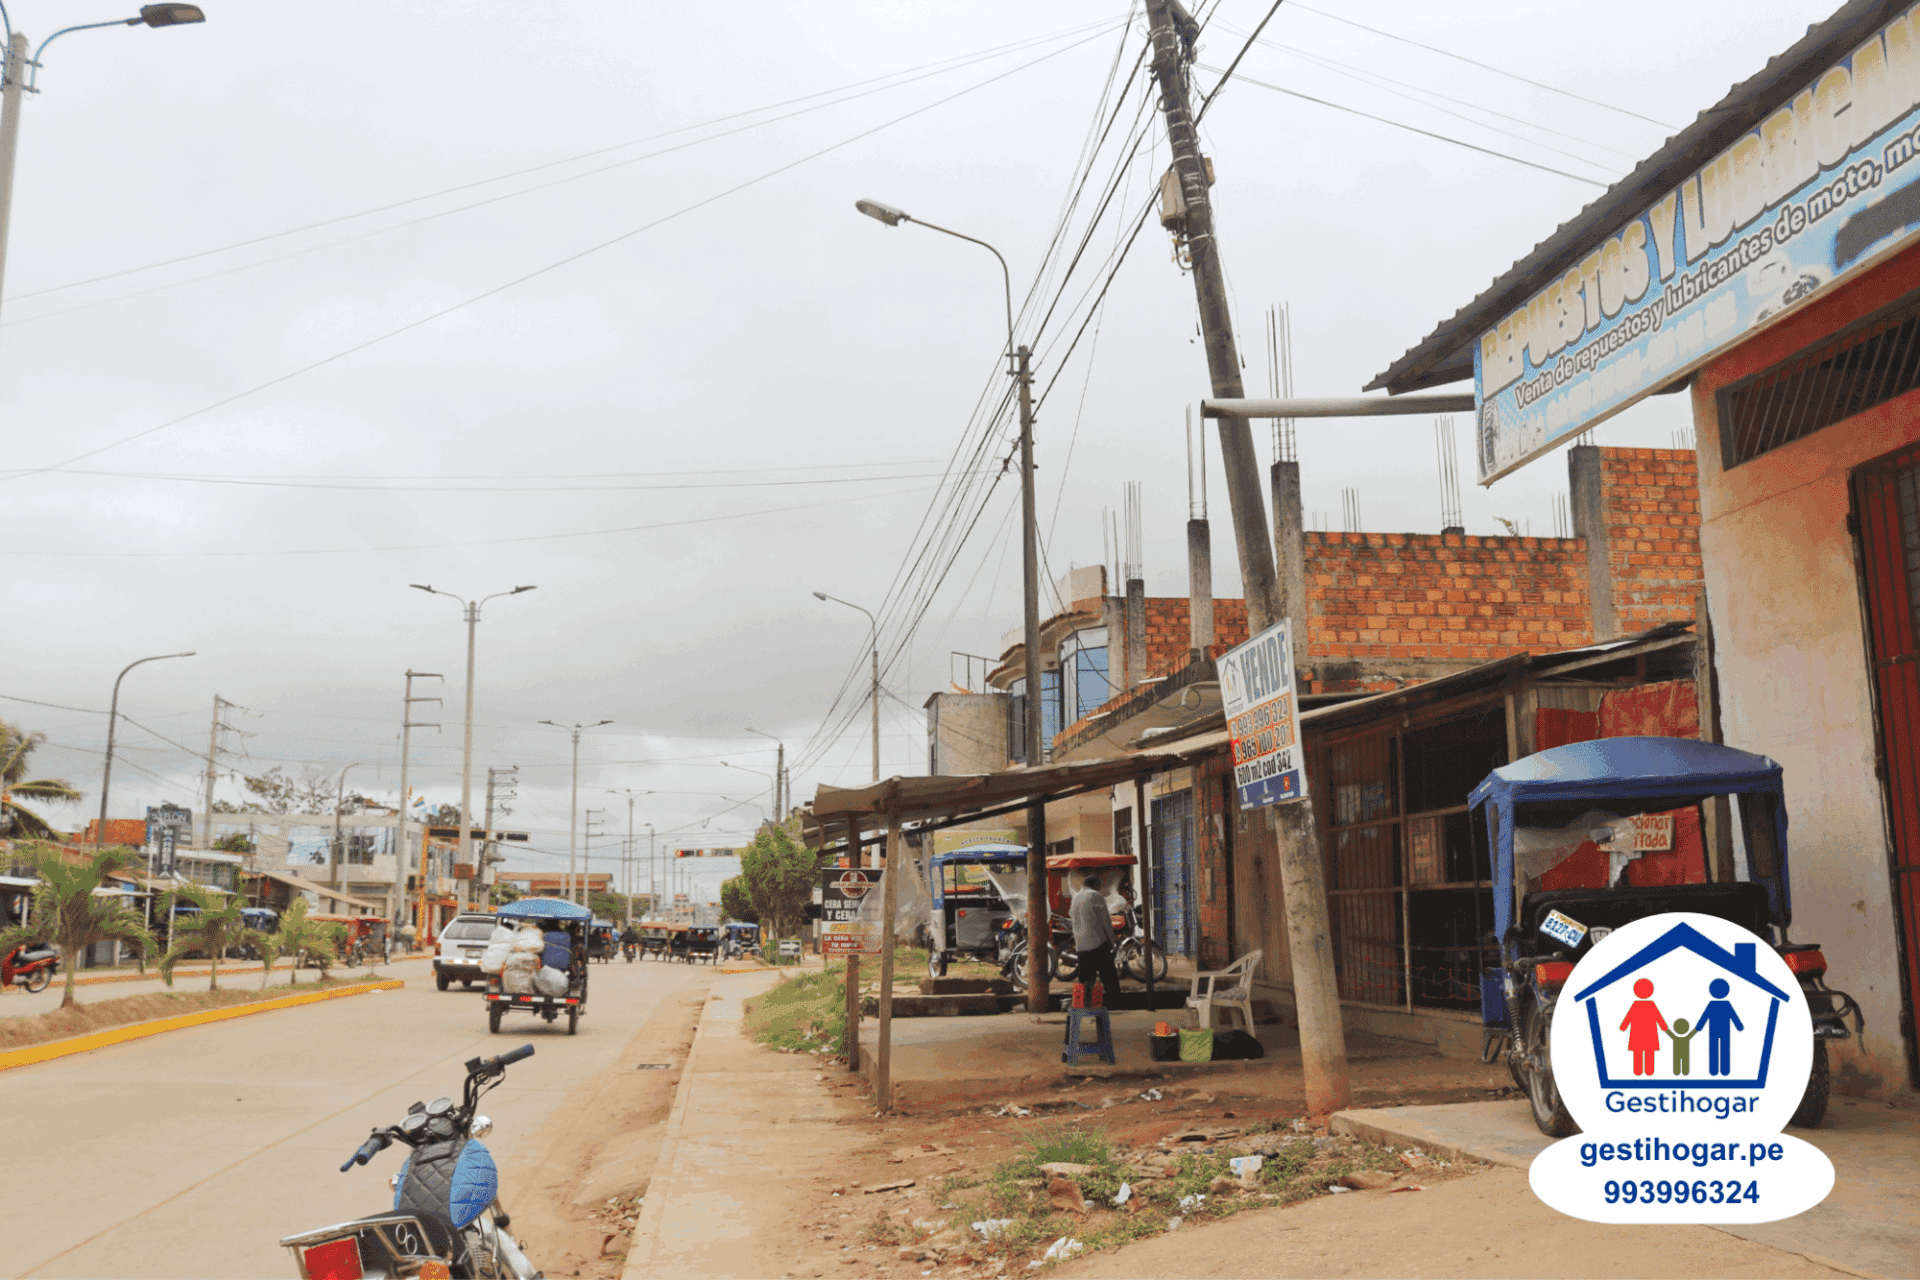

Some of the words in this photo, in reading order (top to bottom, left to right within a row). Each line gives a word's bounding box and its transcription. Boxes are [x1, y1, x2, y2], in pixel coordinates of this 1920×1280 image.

[1648, 190, 1677, 285] Y
[1515, 371, 1553, 409] Venta
[1553, 355, 1574, 386] de
[1575, 306, 1651, 374] repuestos
[1649, 297, 1665, 332] y
[1665, 226, 1773, 316] lubricantes
[1773, 204, 1806, 245] de
[1807, 160, 1883, 224] moto,
[1240, 630, 1290, 704] VENDE
[1242, 737, 1258, 760] 965
[1262, 755, 1276, 777] cod
[824, 900, 842, 909] CERA
